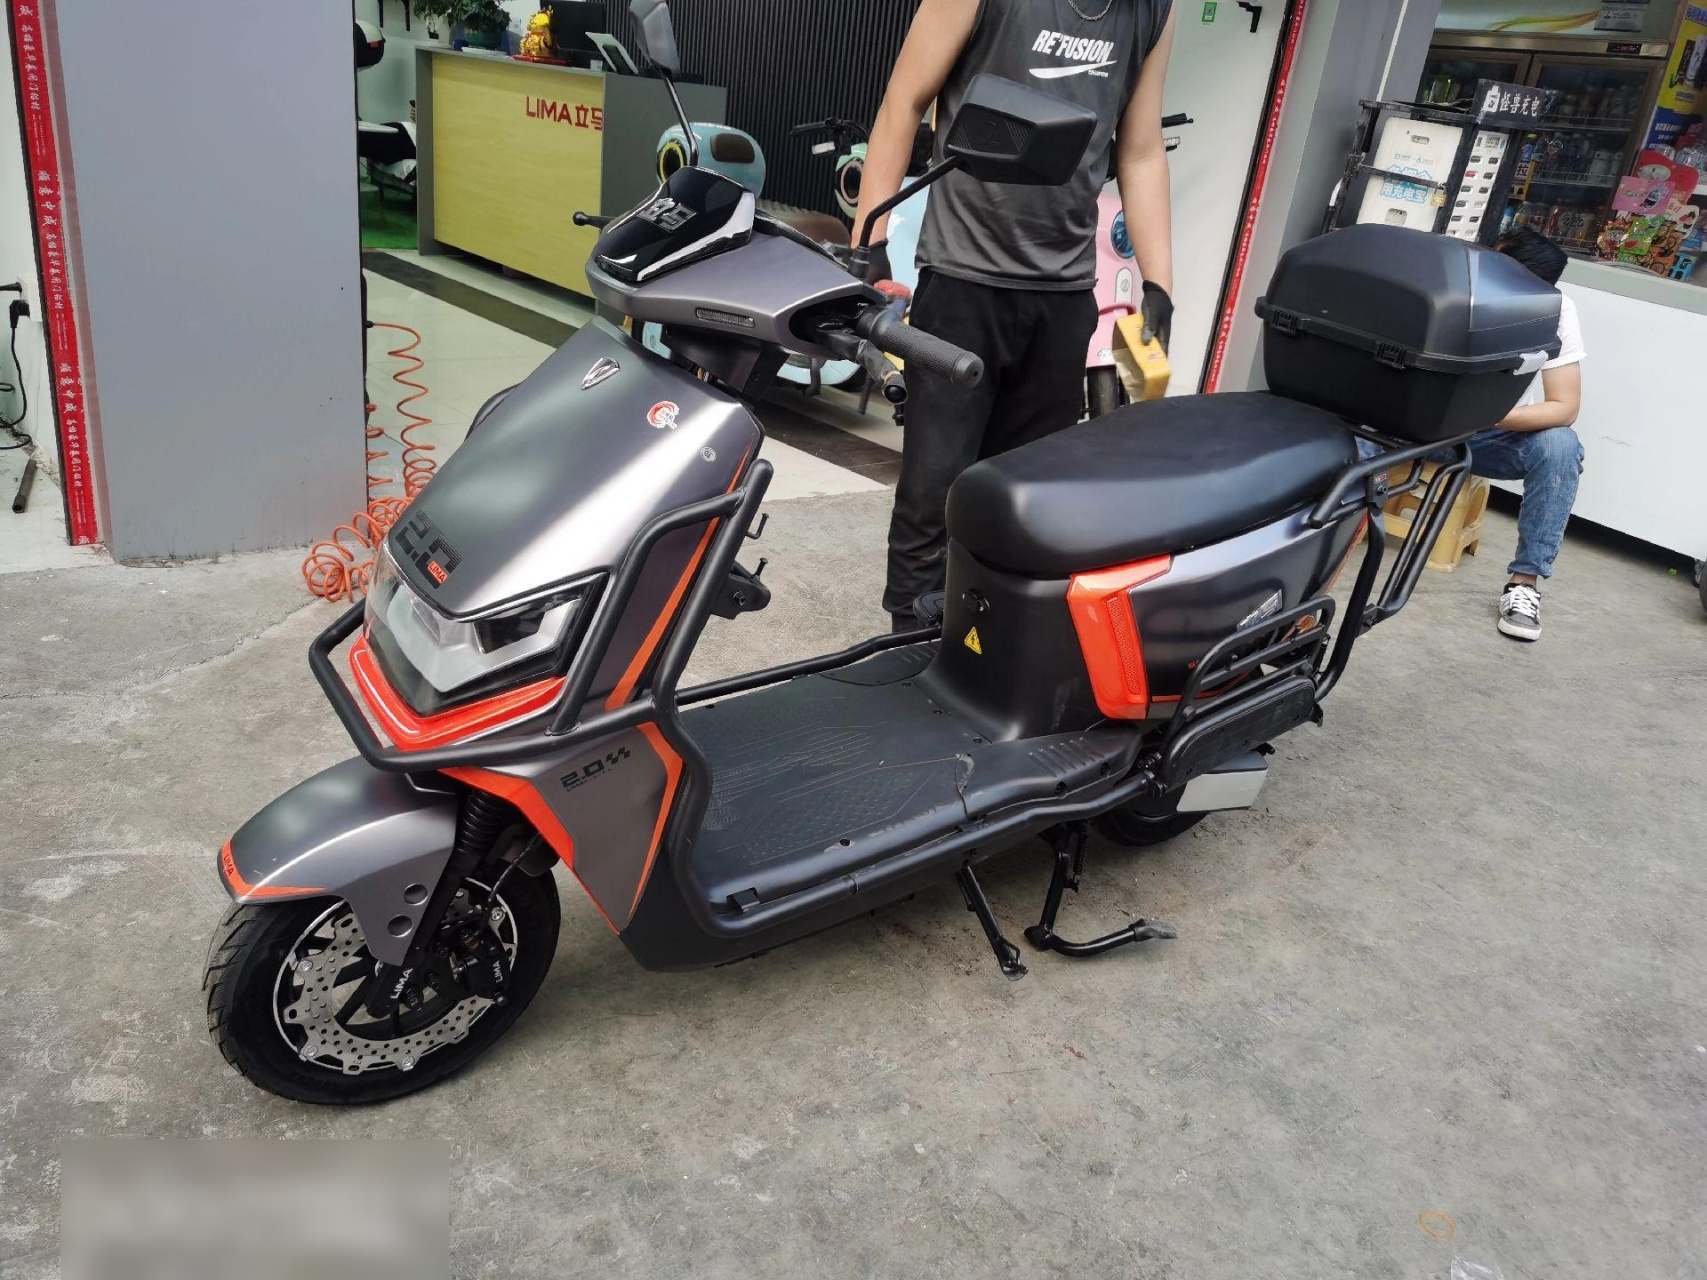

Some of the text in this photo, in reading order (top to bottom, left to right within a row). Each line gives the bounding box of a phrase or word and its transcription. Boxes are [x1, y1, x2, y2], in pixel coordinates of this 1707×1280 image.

[526, 95, 603, 131] LIMA 立马
[1499, 90, 1540, 117] 怪兽充电
[428, 561, 448, 584] LIMA
[390, 967, 414, 999] LIMA
[495, 960, 503, 983] LIMA
